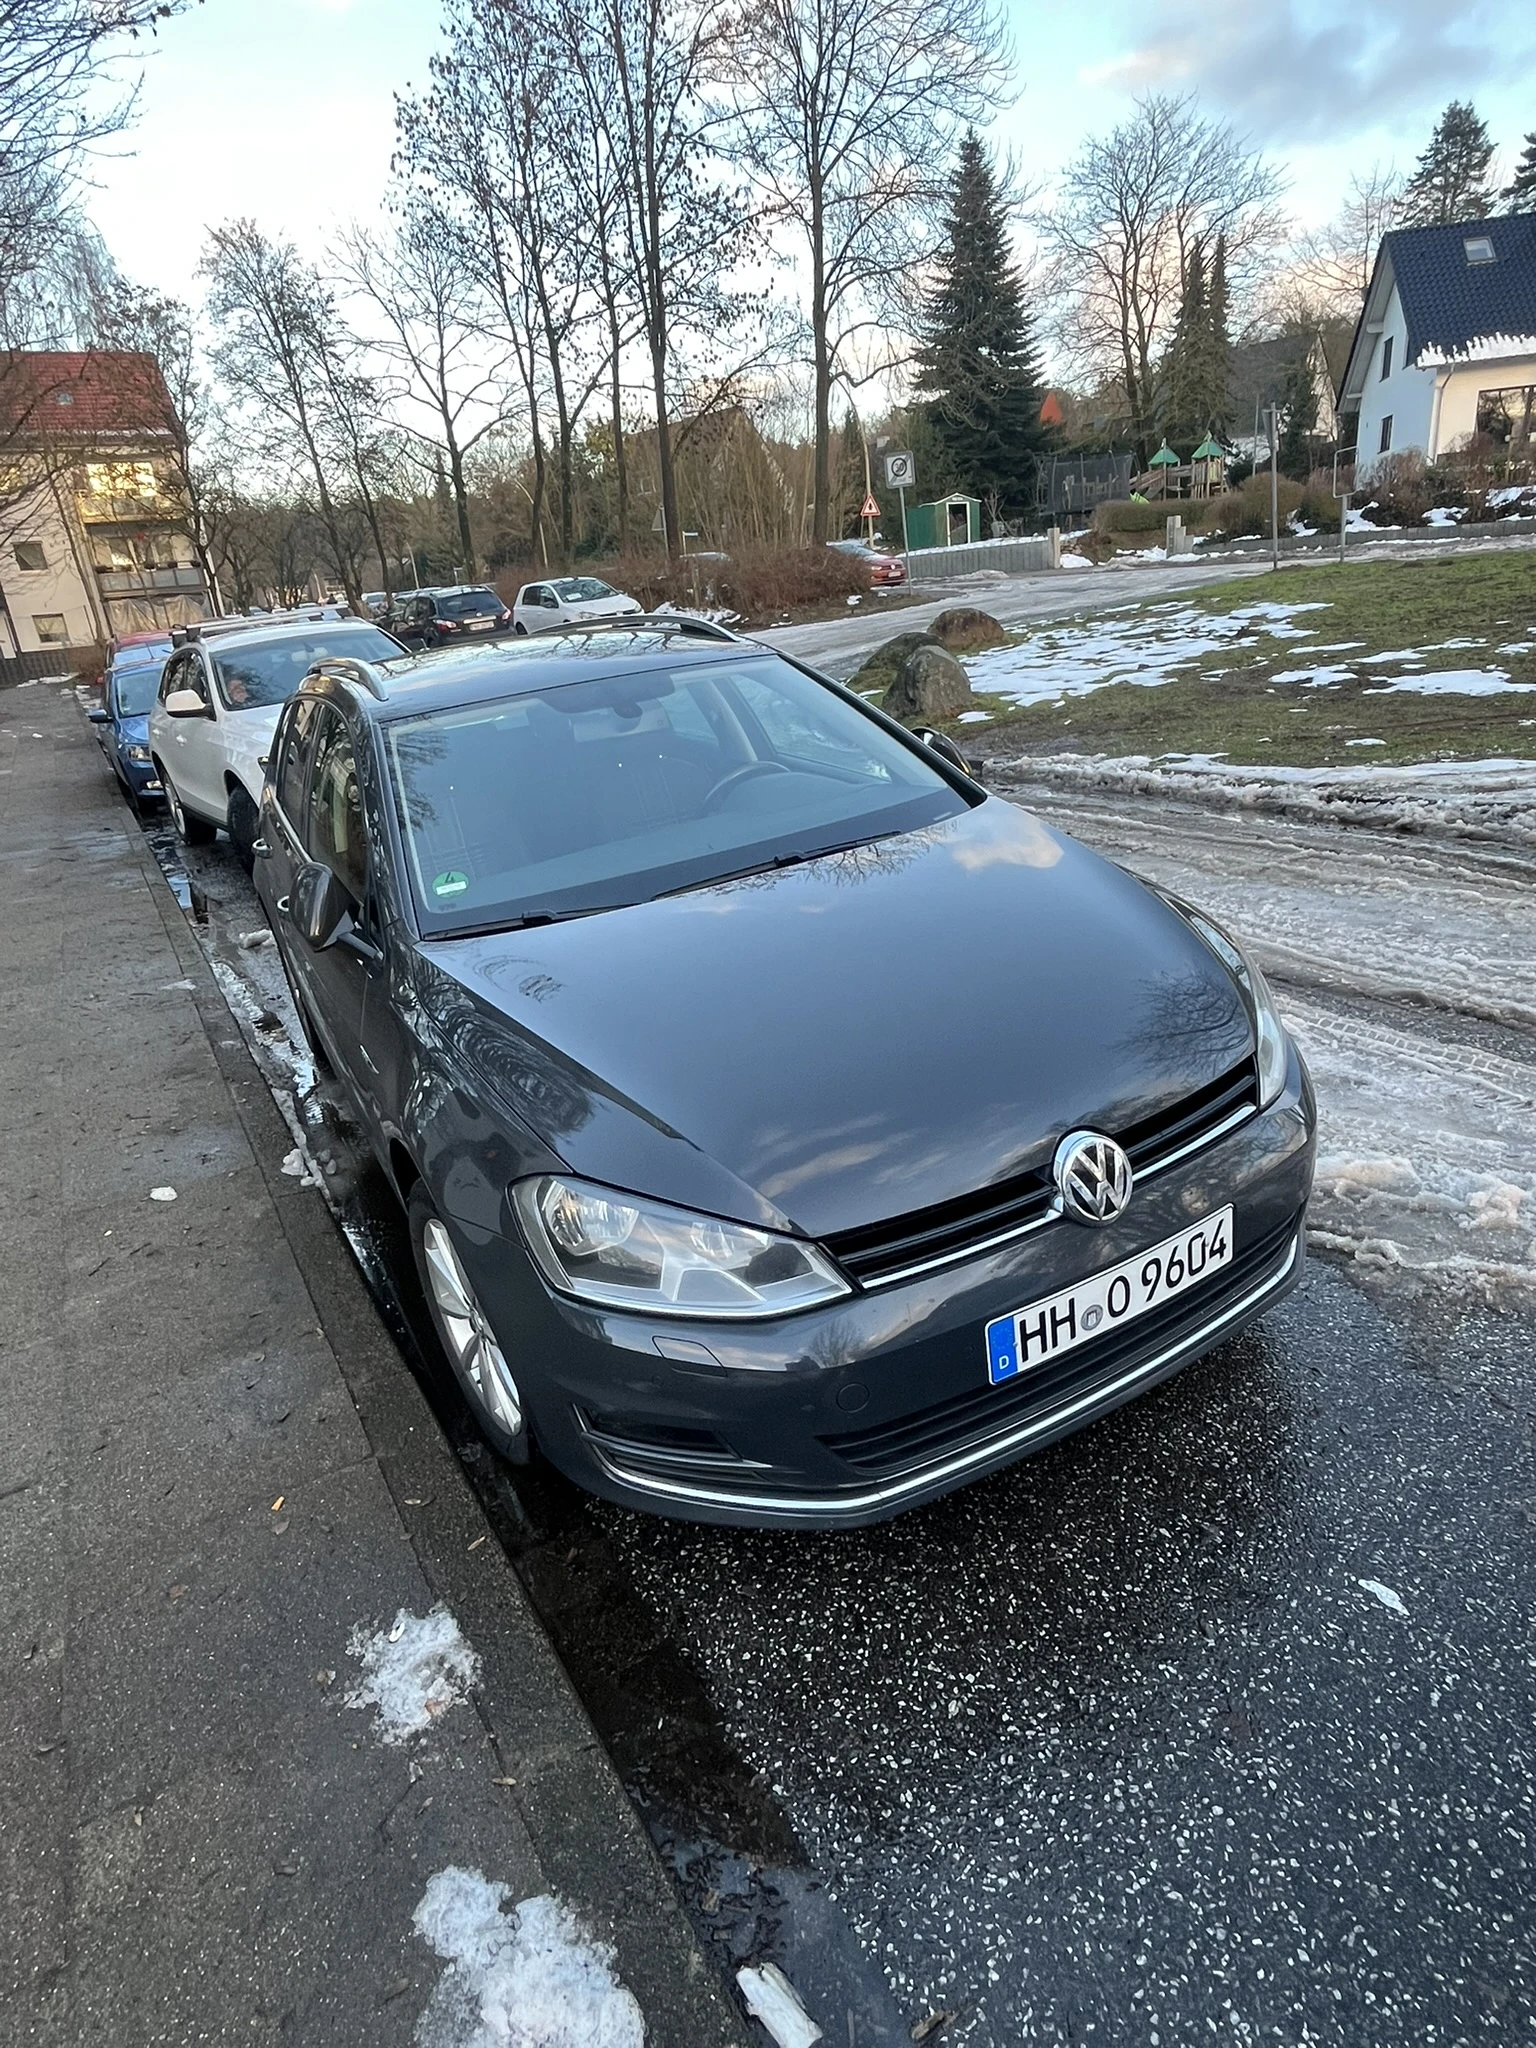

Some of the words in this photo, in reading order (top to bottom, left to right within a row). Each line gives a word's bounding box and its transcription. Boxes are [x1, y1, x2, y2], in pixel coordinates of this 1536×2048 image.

[1065, 1137, 1129, 1222] VW
[1019, 1297, 1077, 1363] HH
[1107, 1275, 1130, 1319] O
[1141, 1219, 1227, 1302] 9604
[999, 1355, 1009, 1370] D
